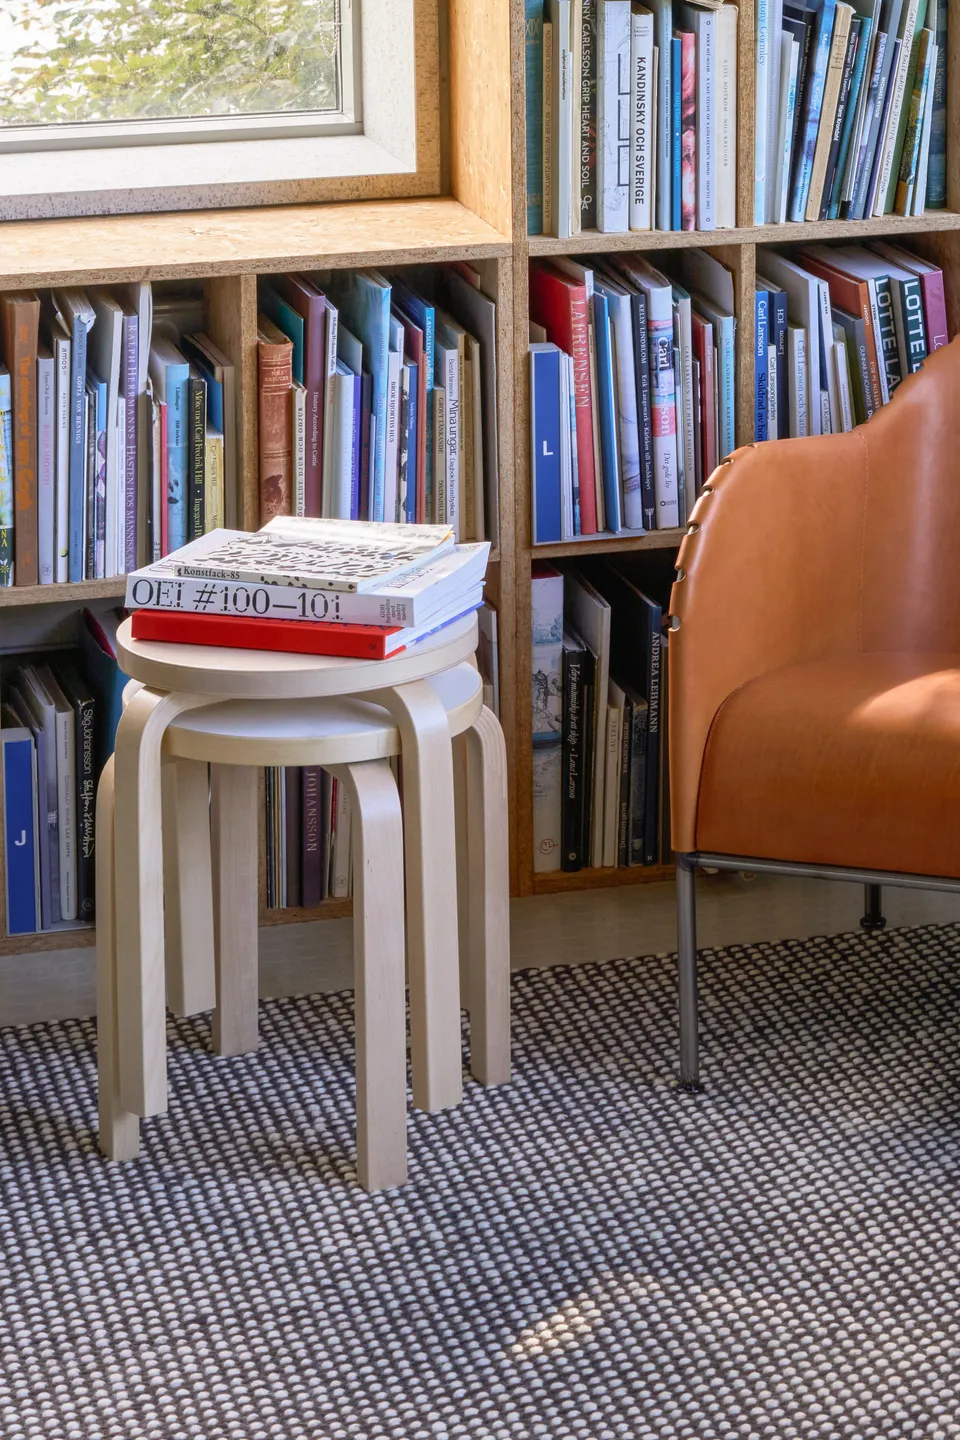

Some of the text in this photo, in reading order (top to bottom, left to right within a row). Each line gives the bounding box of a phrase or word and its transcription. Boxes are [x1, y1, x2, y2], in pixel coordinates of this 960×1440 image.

[582, 24, 590, 77] CARLSSON
[758, 26, 768, 66] Gormley
[581, 80, 590, 103] GRIP
[935, 68, 944, 104] Kreuger
[581, 105, 590, 137] HEART
[635, 57, 646, 205] KANDINSKY OCH SVERIGE
[581, 140, 590, 163] AND
[581, 165, 589, 188] SOIL
[638, 304, 646, 325] KELLY
[758, 301, 766, 320] Carl
[875, 278, 897, 350] LOTTE
[904, 281, 925, 353] LOTTE
[569, 299, 591, 408] LAFRENSEN
[639, 327, 647, 364] LINDBLOM
[658, 337, 674, 369] Carl
[758, 321, 767, 356] Larsson
[642, 390, 650, 422] Langemark
[758, 373, 766, 409] Skildrad
[768, 371, 777, 420] Larssongården
[758, 412, 764, 422] av
[126, 324, 137, 568] RALPH HERRMANNS HÄSTEN HOS MÄNNISKAN
[437, 419, 445, 454] TÄNKANDE
[543, 440, 553, 455] L
[643, 427, 652, 451] Kärleken
[193, 391, 203, 528] Möte med Carl Fredrik Hill Ingegerd
[644, 462, 652, 490] landskapet
[183, 566, 240, 580] Konstfack-85
[132, 578, 185, 608] OEI
[569, 663, 580, 682] Varje
[649, 631, 660, 733] ANDREA LEHMANN
[568, 729, 579, 745] skåp
[569, 753, 579, 771] Lena
[568, 772, 579, 798] Larsson
[306, 771, 317, 851] JOHANSSON
[14, 830, 26, 846] J
